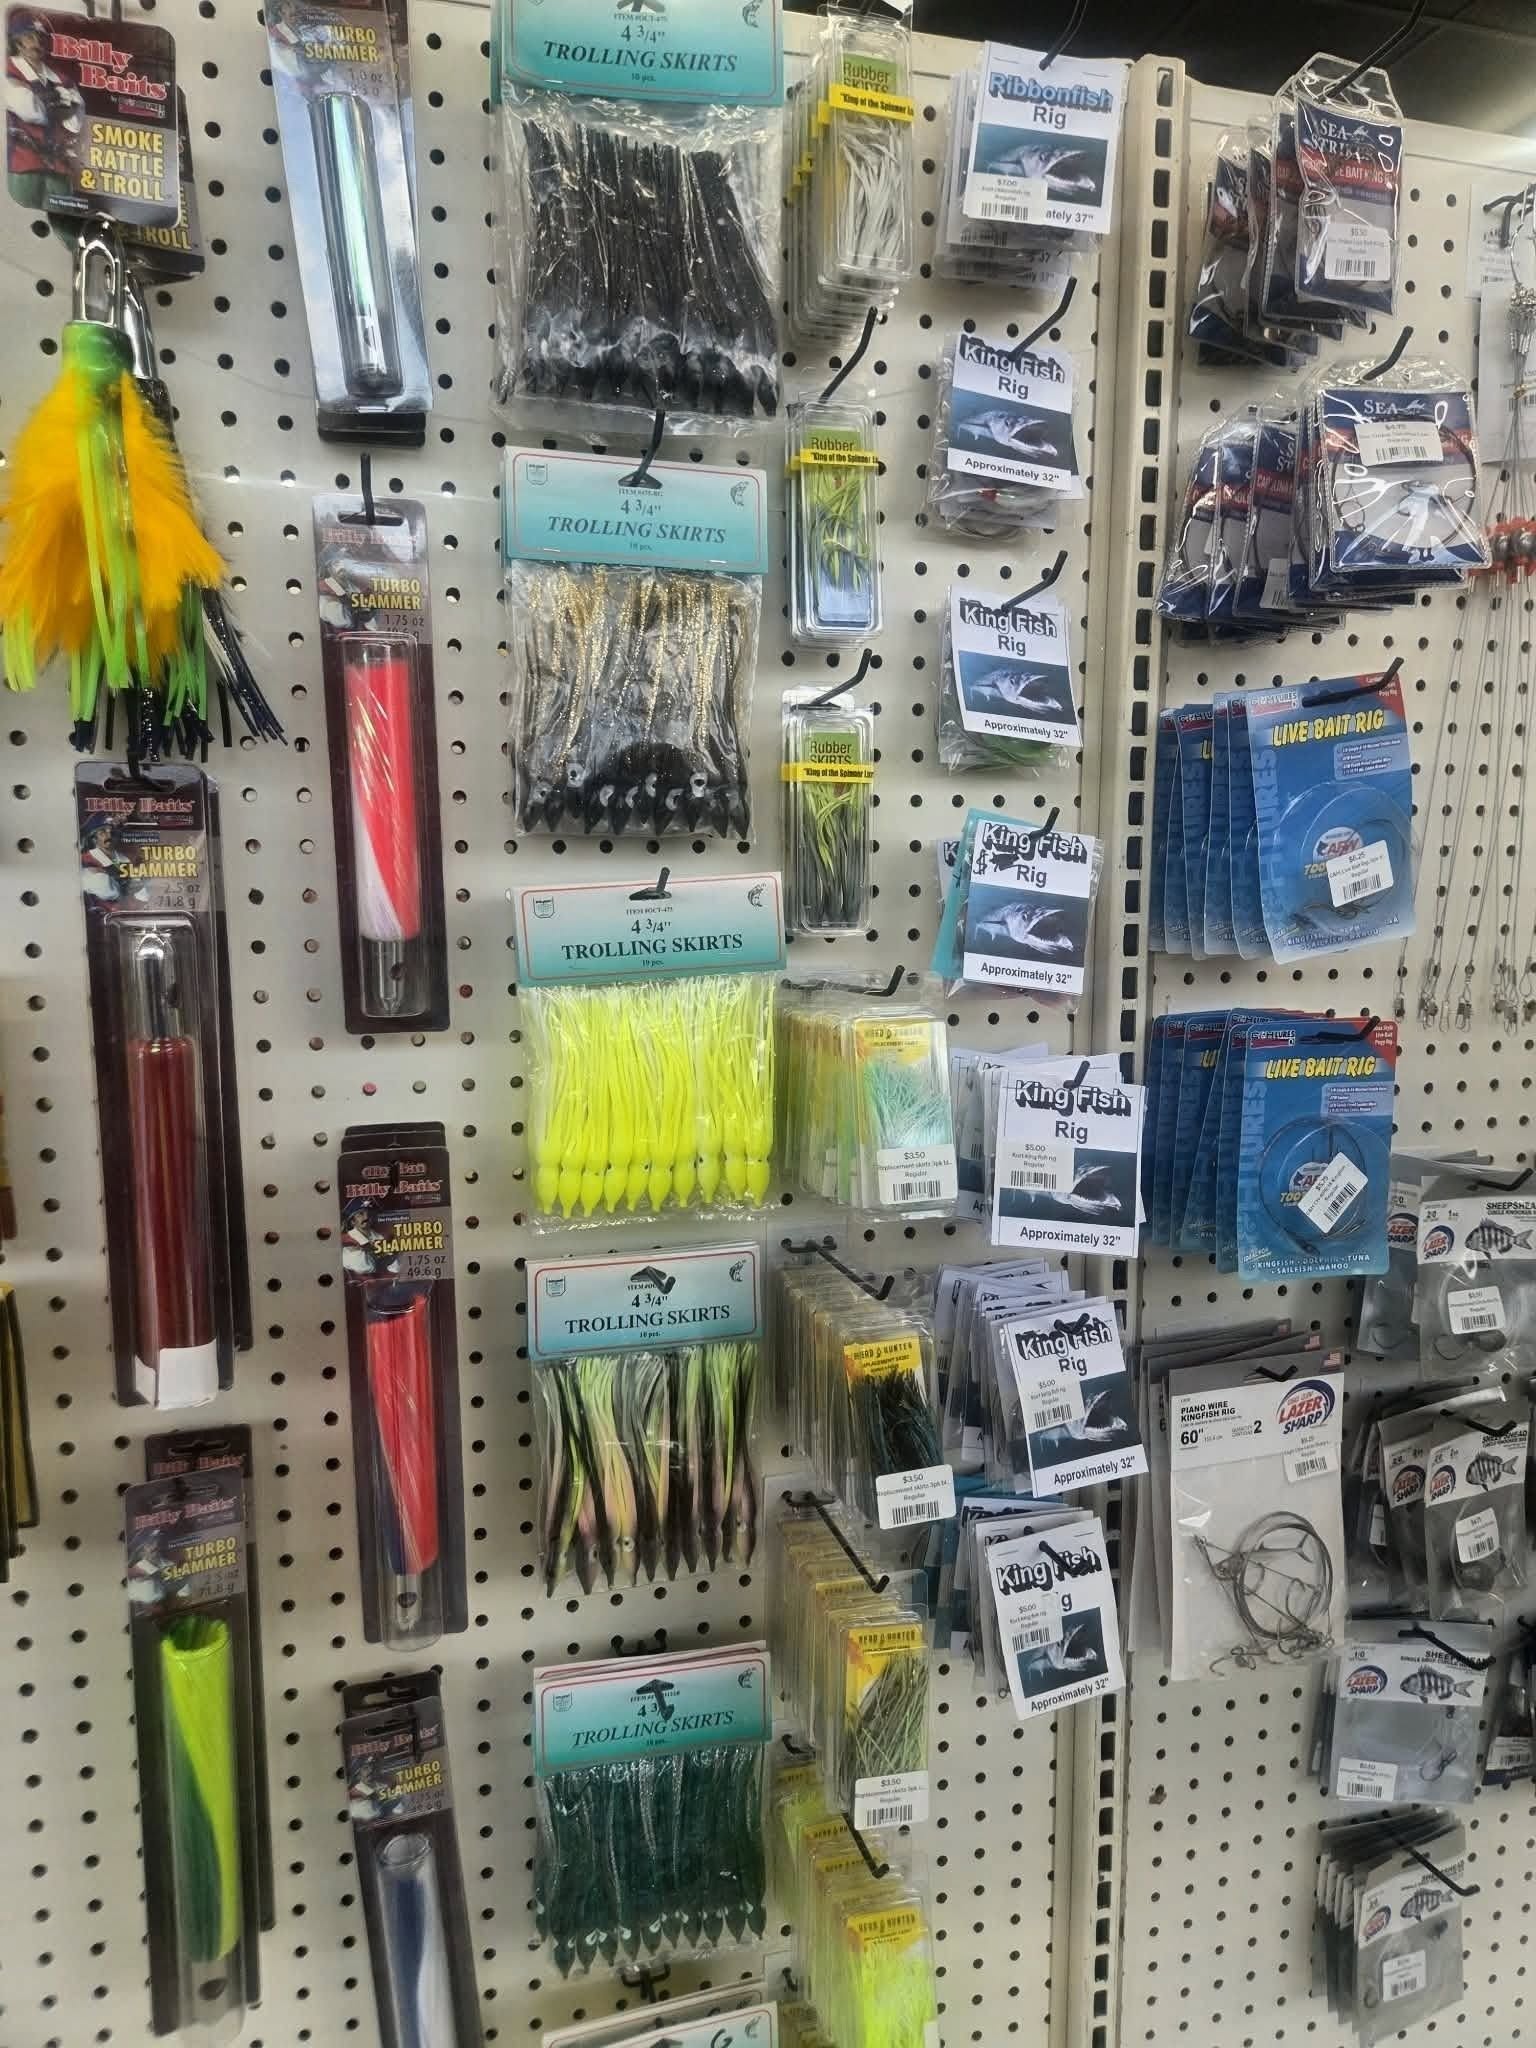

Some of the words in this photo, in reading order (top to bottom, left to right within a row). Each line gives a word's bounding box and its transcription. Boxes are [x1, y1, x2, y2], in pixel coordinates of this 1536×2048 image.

[621, 24, 631, 42] 4
[51, 33, 133, 73] Billy
[304, 42, 380, 63] SLAMMER
[543, 40, 655, 68] TROLLING
[659, 52, 737, 72] SKIRTS
[80, 63, 168, 101] Baits
[843, 62, 889, 83] Rubber
[989, 72, 1113, 113] Ribbonfish
[1033, 106, 1066, 129] Rig
[91, 122, 164, 154] SMOKE
[1320, 118, 1348, 141] SEA
[90, 147, 164, 179] RATTLE
[81, 169, 97, 191] &
[100, 171, 164, 201] TROLL
[960, 334, 1014, 374] King
[1016, 350, 1065, 384] Fish
[999, 376, 1029, 400] Rig
[1363, 399, 1398, 418] SEA
[811, 437, 854, 451] Rubber
[965, 458, 1040, 480] Approximately
[620, 499, 630, 515] 4
[548, 516, 653, 538] TROLLING
[656, 523, 727, 543] SKIRTS
[371, 578, 420, 593] TURBO
[351, 592, 421, 609] SLAMMER
[413, 616, 425, 626] oz
[960, 598, 1010, 635] King
[1011, 607, 1058, 638] Fish
[999, 635, 1026, 657] Rig
[985, 720, 1051, 738] Approximately
[1272, 720, 1309, 746] LIVE
[1313, 714, 1351, 740] BAIT
[1354, 709, 1384, 734] RIG
[810, 740, 852, 754] Rubber
[141, 845, 197, 861] TURBO
[982, 822, 1036, 862] King
[1038, 832, 1088, 865] Fish
[120, 862, 197, 878] SLAMMER
[1017, 864, 1048, 888] Rig
[631, 919, 640, 934] 4
[561, 938, 666, 960] TROLLING
[671, 933, 743, 954] SKIRTS
[981, 963, 1054, 984] Approximately
[1265, 1058, 1301, 1080] LIVE
[1305, 1056, 1344, 1078] BAIT
[1346, 1055, 1377, 1078] RIG
[1015, 1080, 1073, 1117] King
[1077, 1085, 1131, 1117] Fish
[1055, 1120, 1088, 1144] Rig
[904, 1152, 926, 1160] $3.50
[394, 1221, 443, 1237] TURBO
[1020, 1226, 1100, 1247] Approximately
[1102, 1235, 1121, 1246] 32"
[374, 1237, 443, 1255] SLAMMER
[408, 1255, 430, 1266] 1.75
[434, 1256, 446, 1265] oz
[1258, 1259, 1294, 1269] KINGFISH
[1347, 1254, 1370, 1262] TUNA
[1277, 1265, 1313, 1275] SAILFISH
[434, 1268, 442, 1279] g
[631, 1295, 640, 1308] 4
[564, 1312, 663, 1334] TROLLING
[667, 1305, 730, 1325] SKIRTS
[1015, 1330, 1069, 1361] King
[1059, 1357, 1087, 1377] Rig
[1039, 1379, 1056, 1389] $5.00
[1181, 1403, 1206, 1415] PIANO
[1207, 1401, 1229, 1411] WIRE
[1181, 1410, 1220, 1423] KINGFISH
[1221, 1408, 1236, 1418] RIG
[1279, 1395, 1323, 1424] LAZER
[1253, 1420, 1262, 1434] 2
[1282, 1410, 1323, 1435] SHARP
[1180, 1428, 1204, 1445] 60"
[903, 1474, 924, 1484] $3.50
[1054, 1461, 1119, 1486] Approximately
[1120, 1455, 1136, 1469] 32"
[184, 1537, 236, 1558] TURBO
[164, 1553, 236, 1581] SLAMMER
[996, 1562, 1054, 1596] King
[1019, 1604, 1037, 1614] $5.00
[1031, 1687, 1094, 1712] Approximately
[1095, 1676, 1110, 1691] 32"
[637, 1704, 646, 1717] 4
[571, 1719, 666, 1748] TROLLING
[670, 1711, 735, 1732] SKIRTS
[395, 1761, 441, 1784] TURBO
[379, 1775, 442, 1802] SLAMMER
